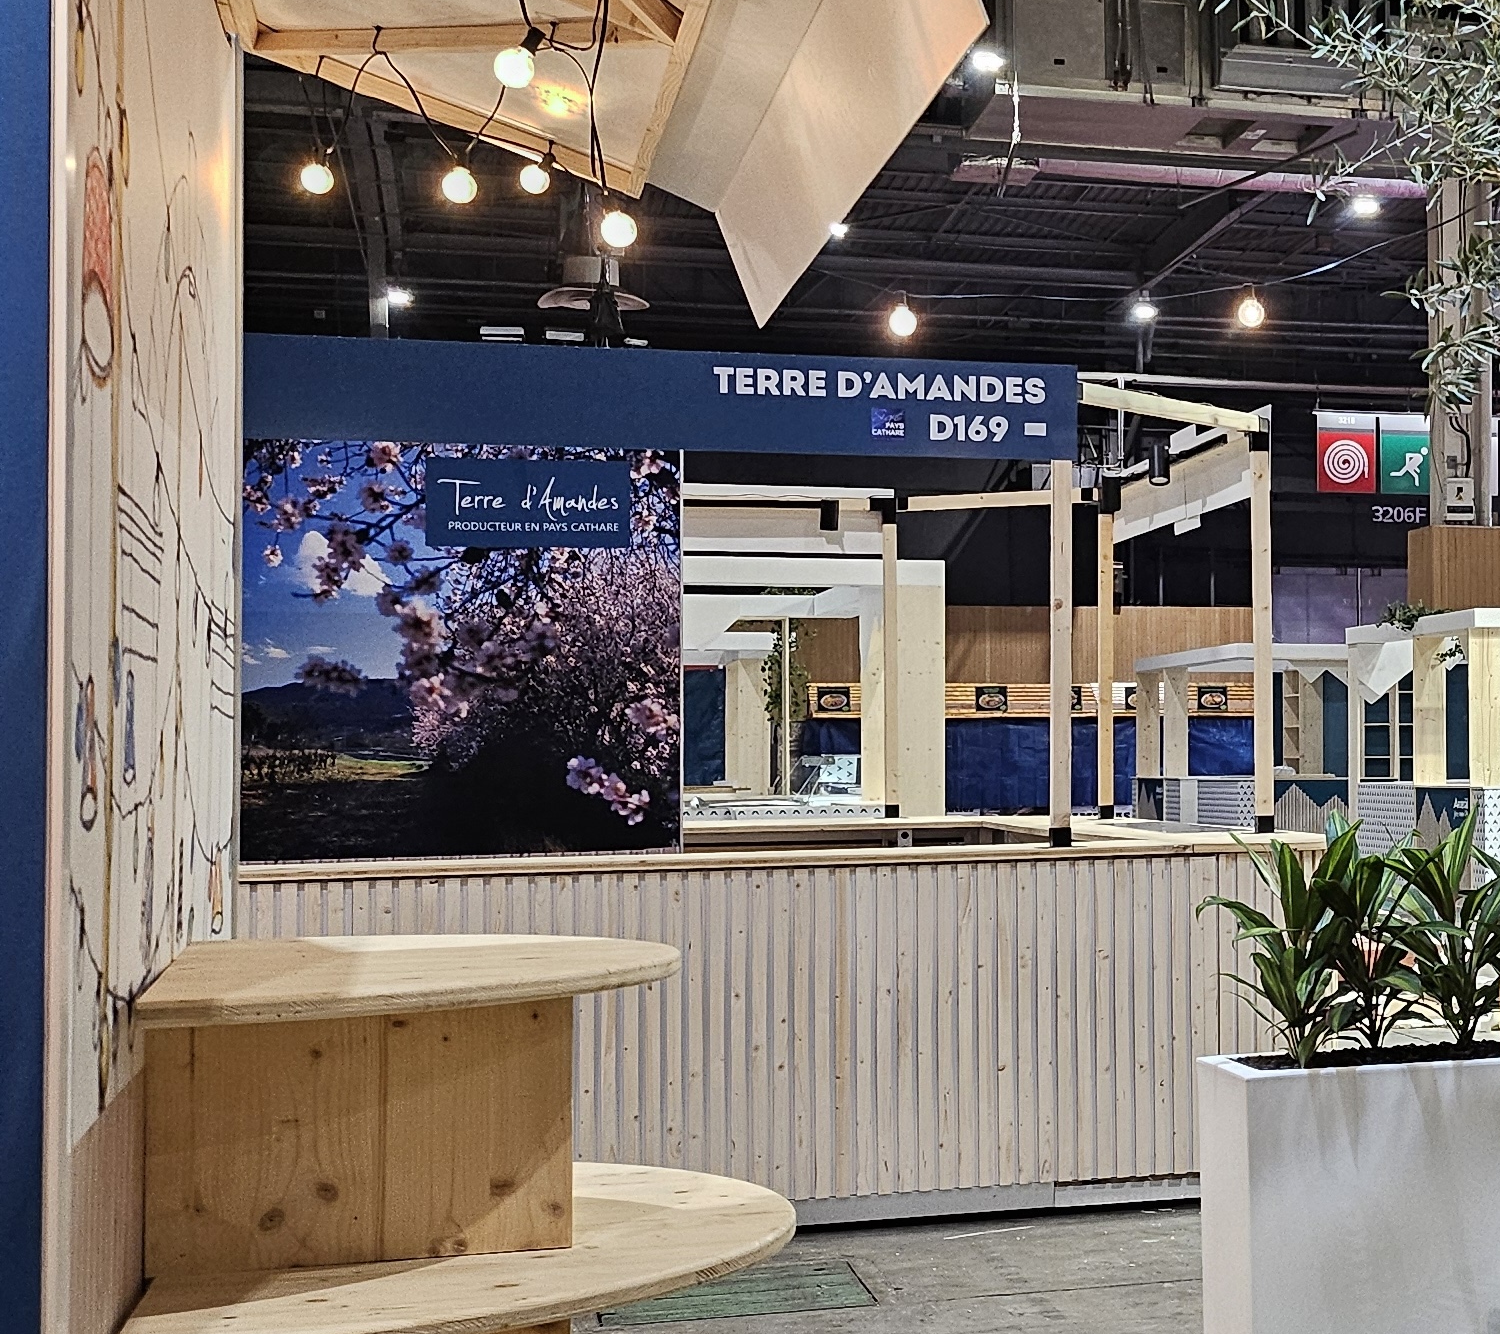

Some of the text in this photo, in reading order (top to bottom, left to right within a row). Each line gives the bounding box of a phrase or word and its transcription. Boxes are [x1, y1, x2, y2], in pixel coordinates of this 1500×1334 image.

[713, 366, 1047, 405] TERRE D'AMANDES
[929, 413, 1009, 443] D169
[436, 476, 619, 521] Terre d'Amandes
[448, 521, 619, 532] PRODUCTEUR EN PAYS CATHARE
[1371, 506, 1427, 524] 3206F
